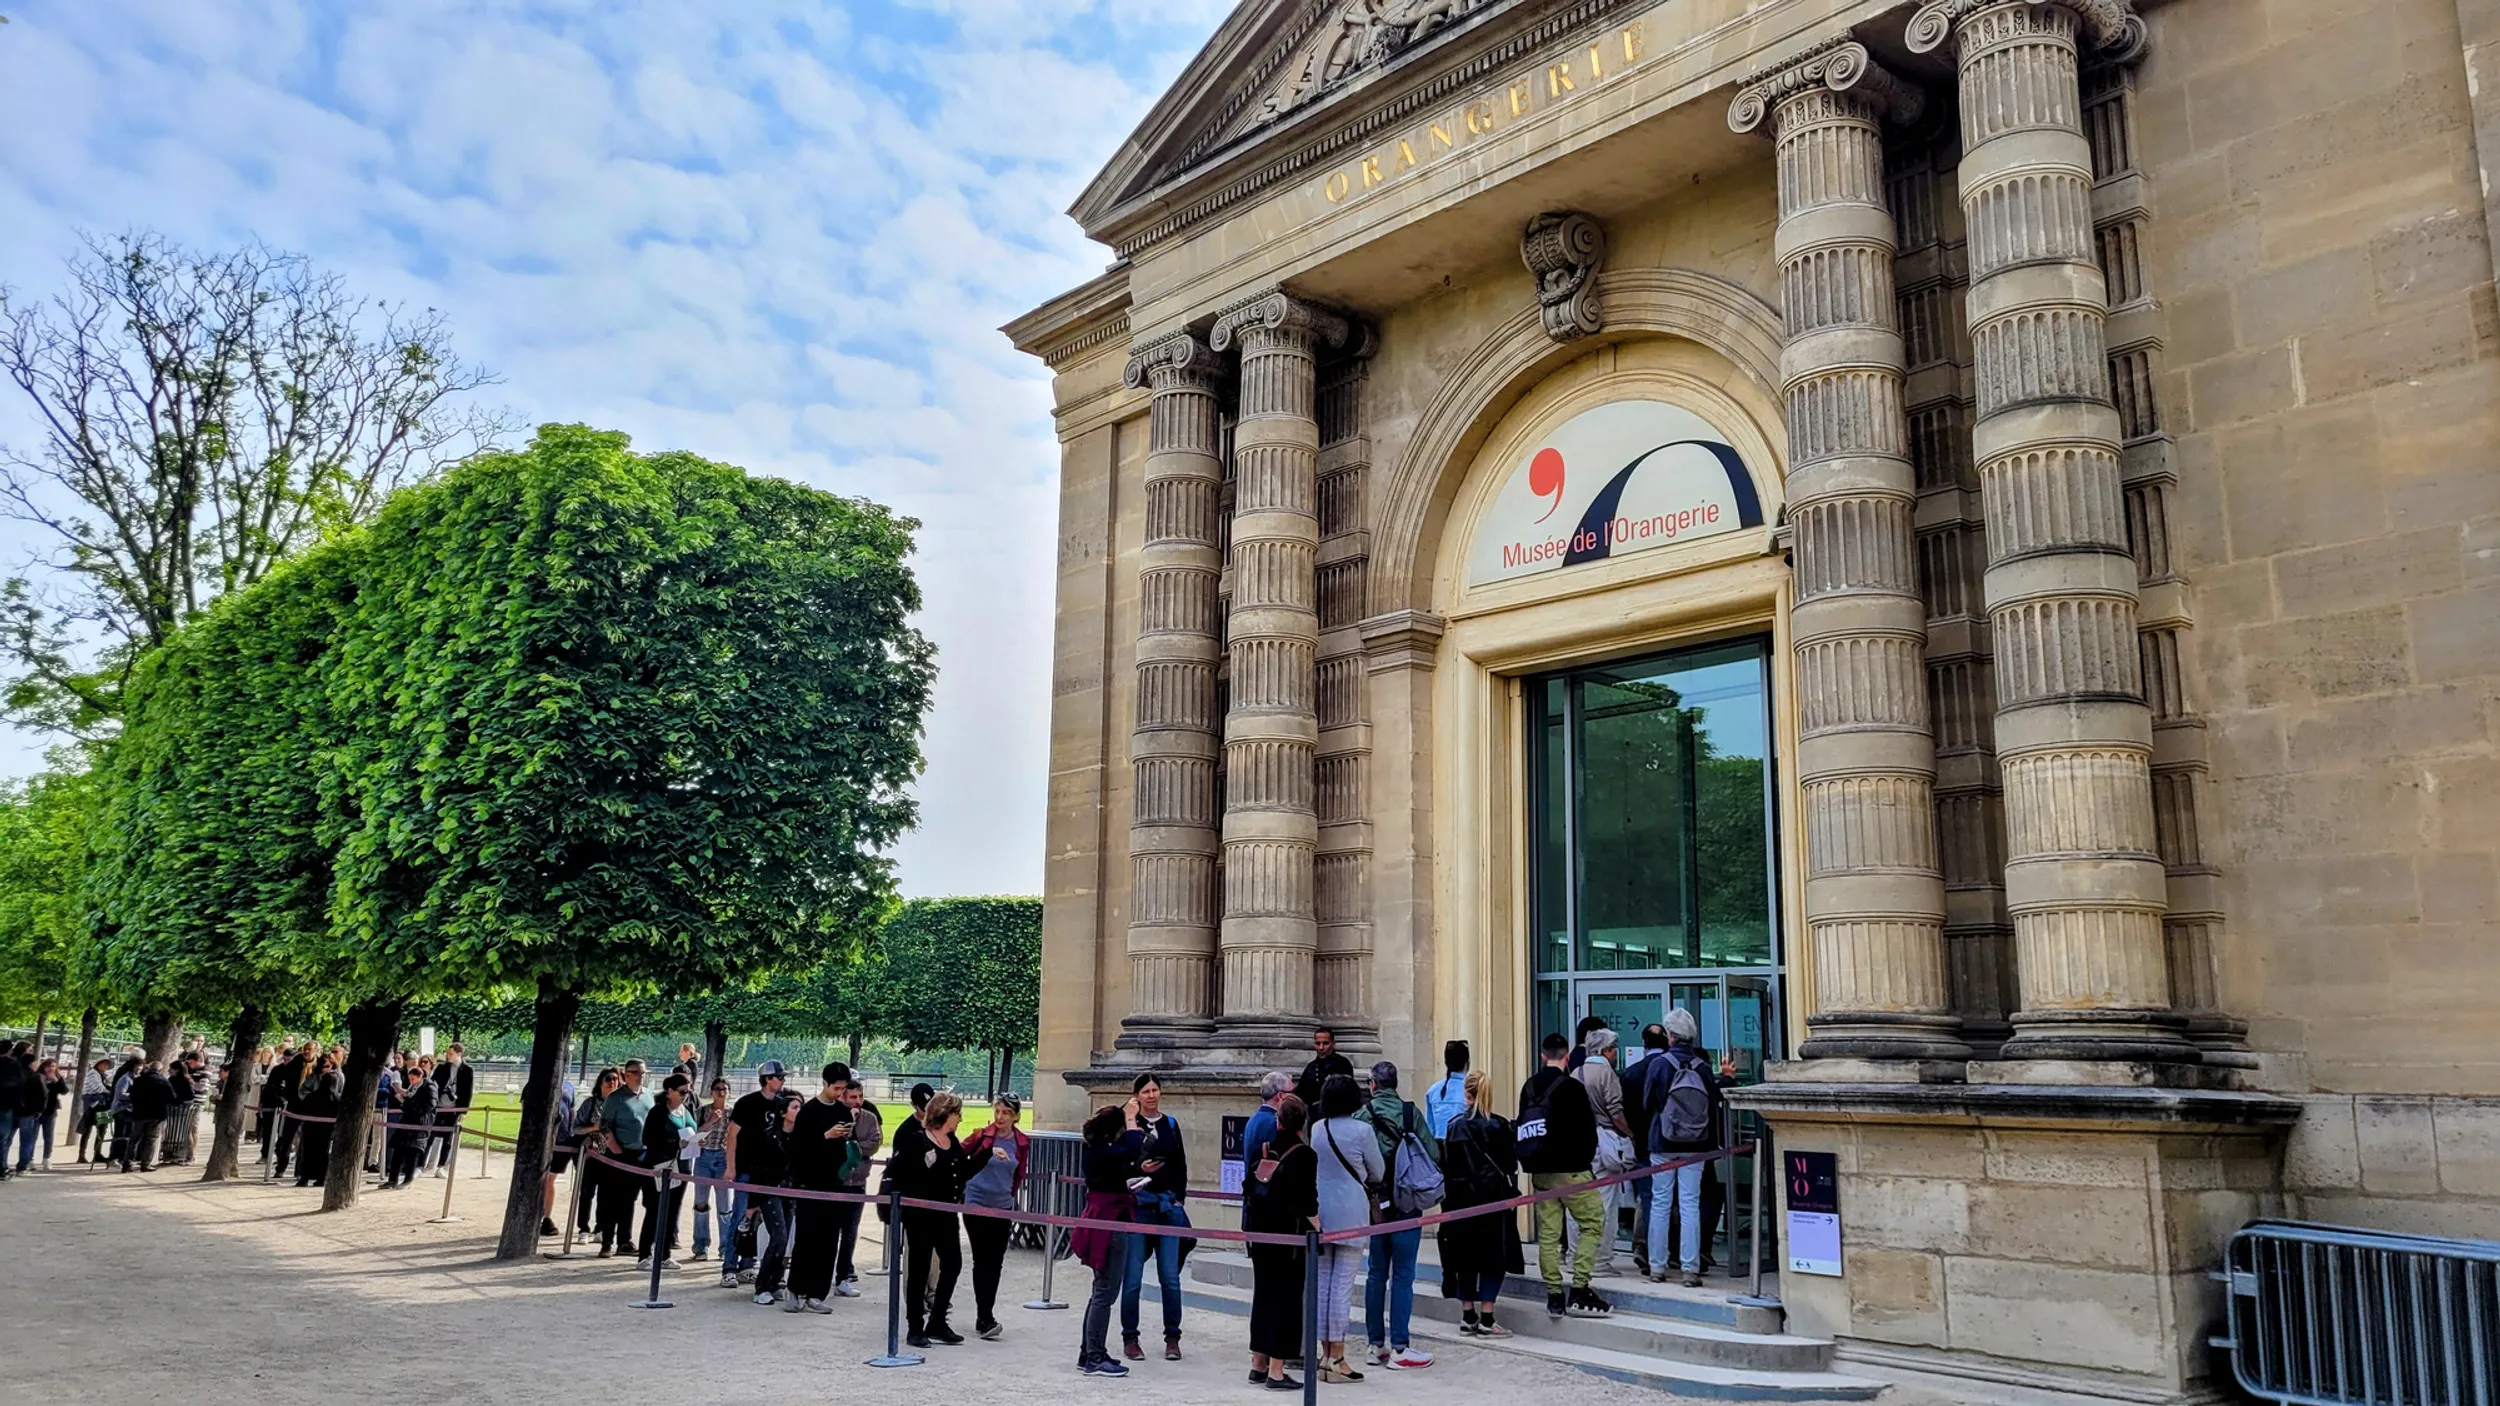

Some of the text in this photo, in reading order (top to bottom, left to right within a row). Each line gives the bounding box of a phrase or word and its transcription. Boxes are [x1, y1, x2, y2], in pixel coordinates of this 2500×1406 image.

[1324, 22, 1644, 203] ORANGERIE
[1502, 499, 1720, 569] Musée de l'Orangerie
[1517, 1118, 1547, 1142] VANS
[1794, 1157, 1807, 1174] M
